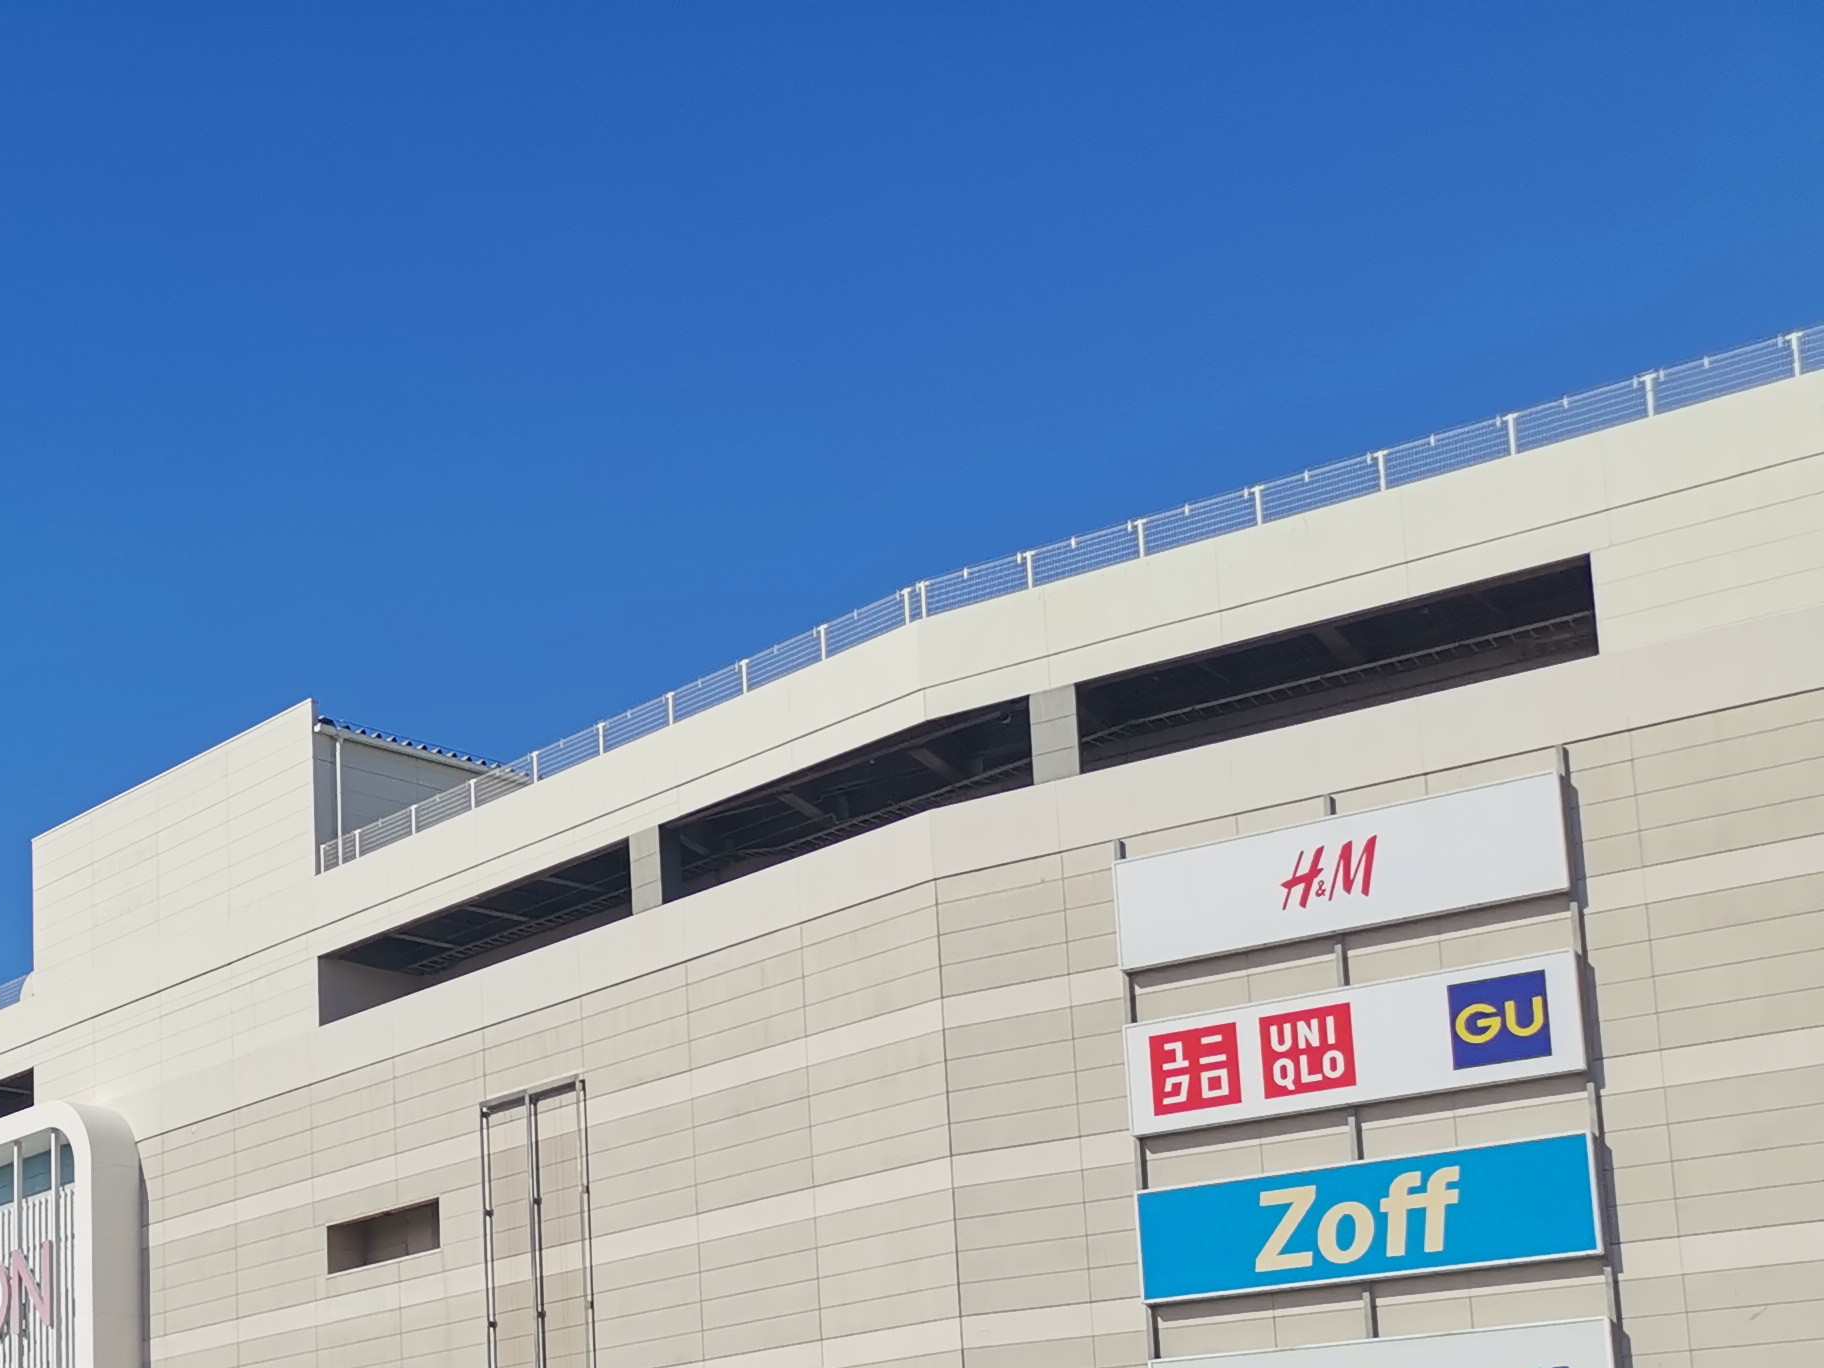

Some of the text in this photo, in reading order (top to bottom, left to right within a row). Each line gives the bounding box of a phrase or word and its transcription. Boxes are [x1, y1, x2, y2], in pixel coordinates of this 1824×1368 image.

[1281, 835, 1378, 911] H&M
[1269, 1017, 1336, 1053] UNI
[1455, 995, 1545, 1045] GU
[1272, 1049, 1345, 1091] QLO
[1254, 1165, 1460, 1273] Zoff
